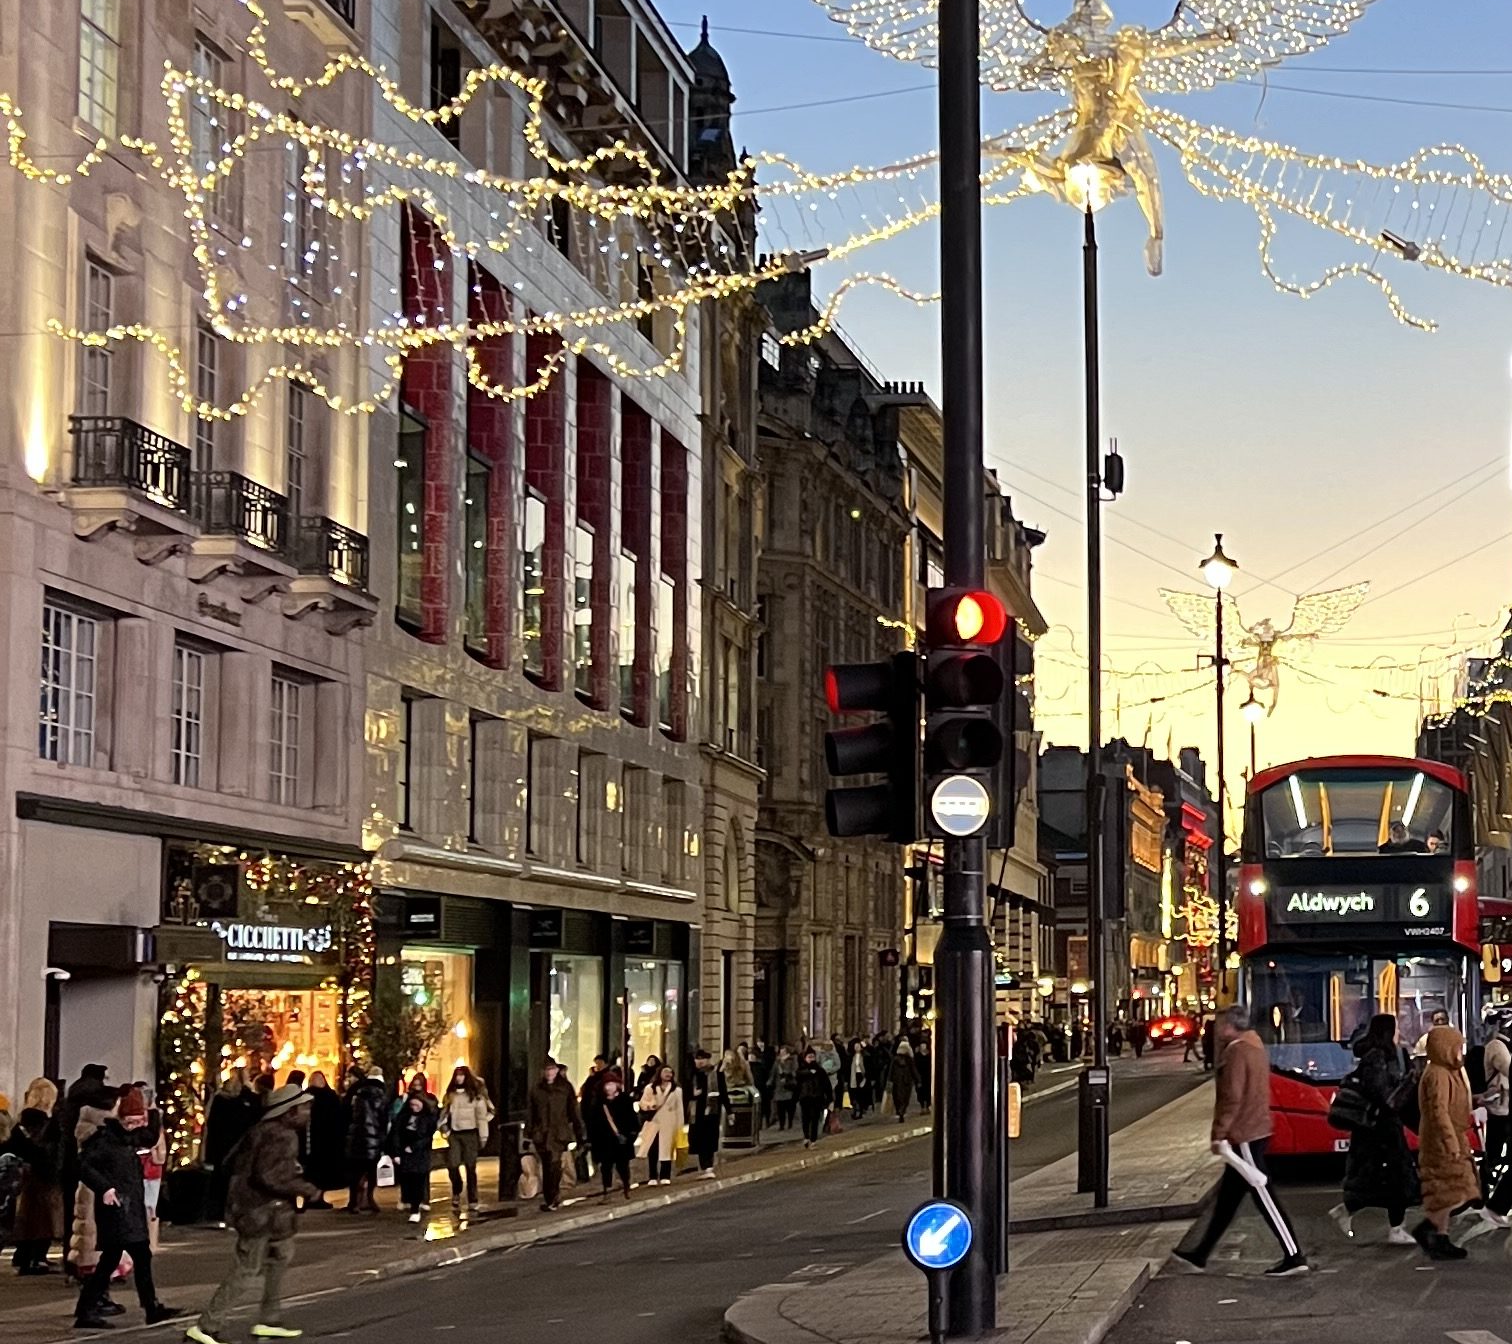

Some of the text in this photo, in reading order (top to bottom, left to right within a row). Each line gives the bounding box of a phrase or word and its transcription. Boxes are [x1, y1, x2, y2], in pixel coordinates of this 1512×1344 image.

[1287, 888, 1430, 917] Aldwych 6
[227, 924, 304, 951] CICCHETTI
[1501, 958, 1512, 973] 9
